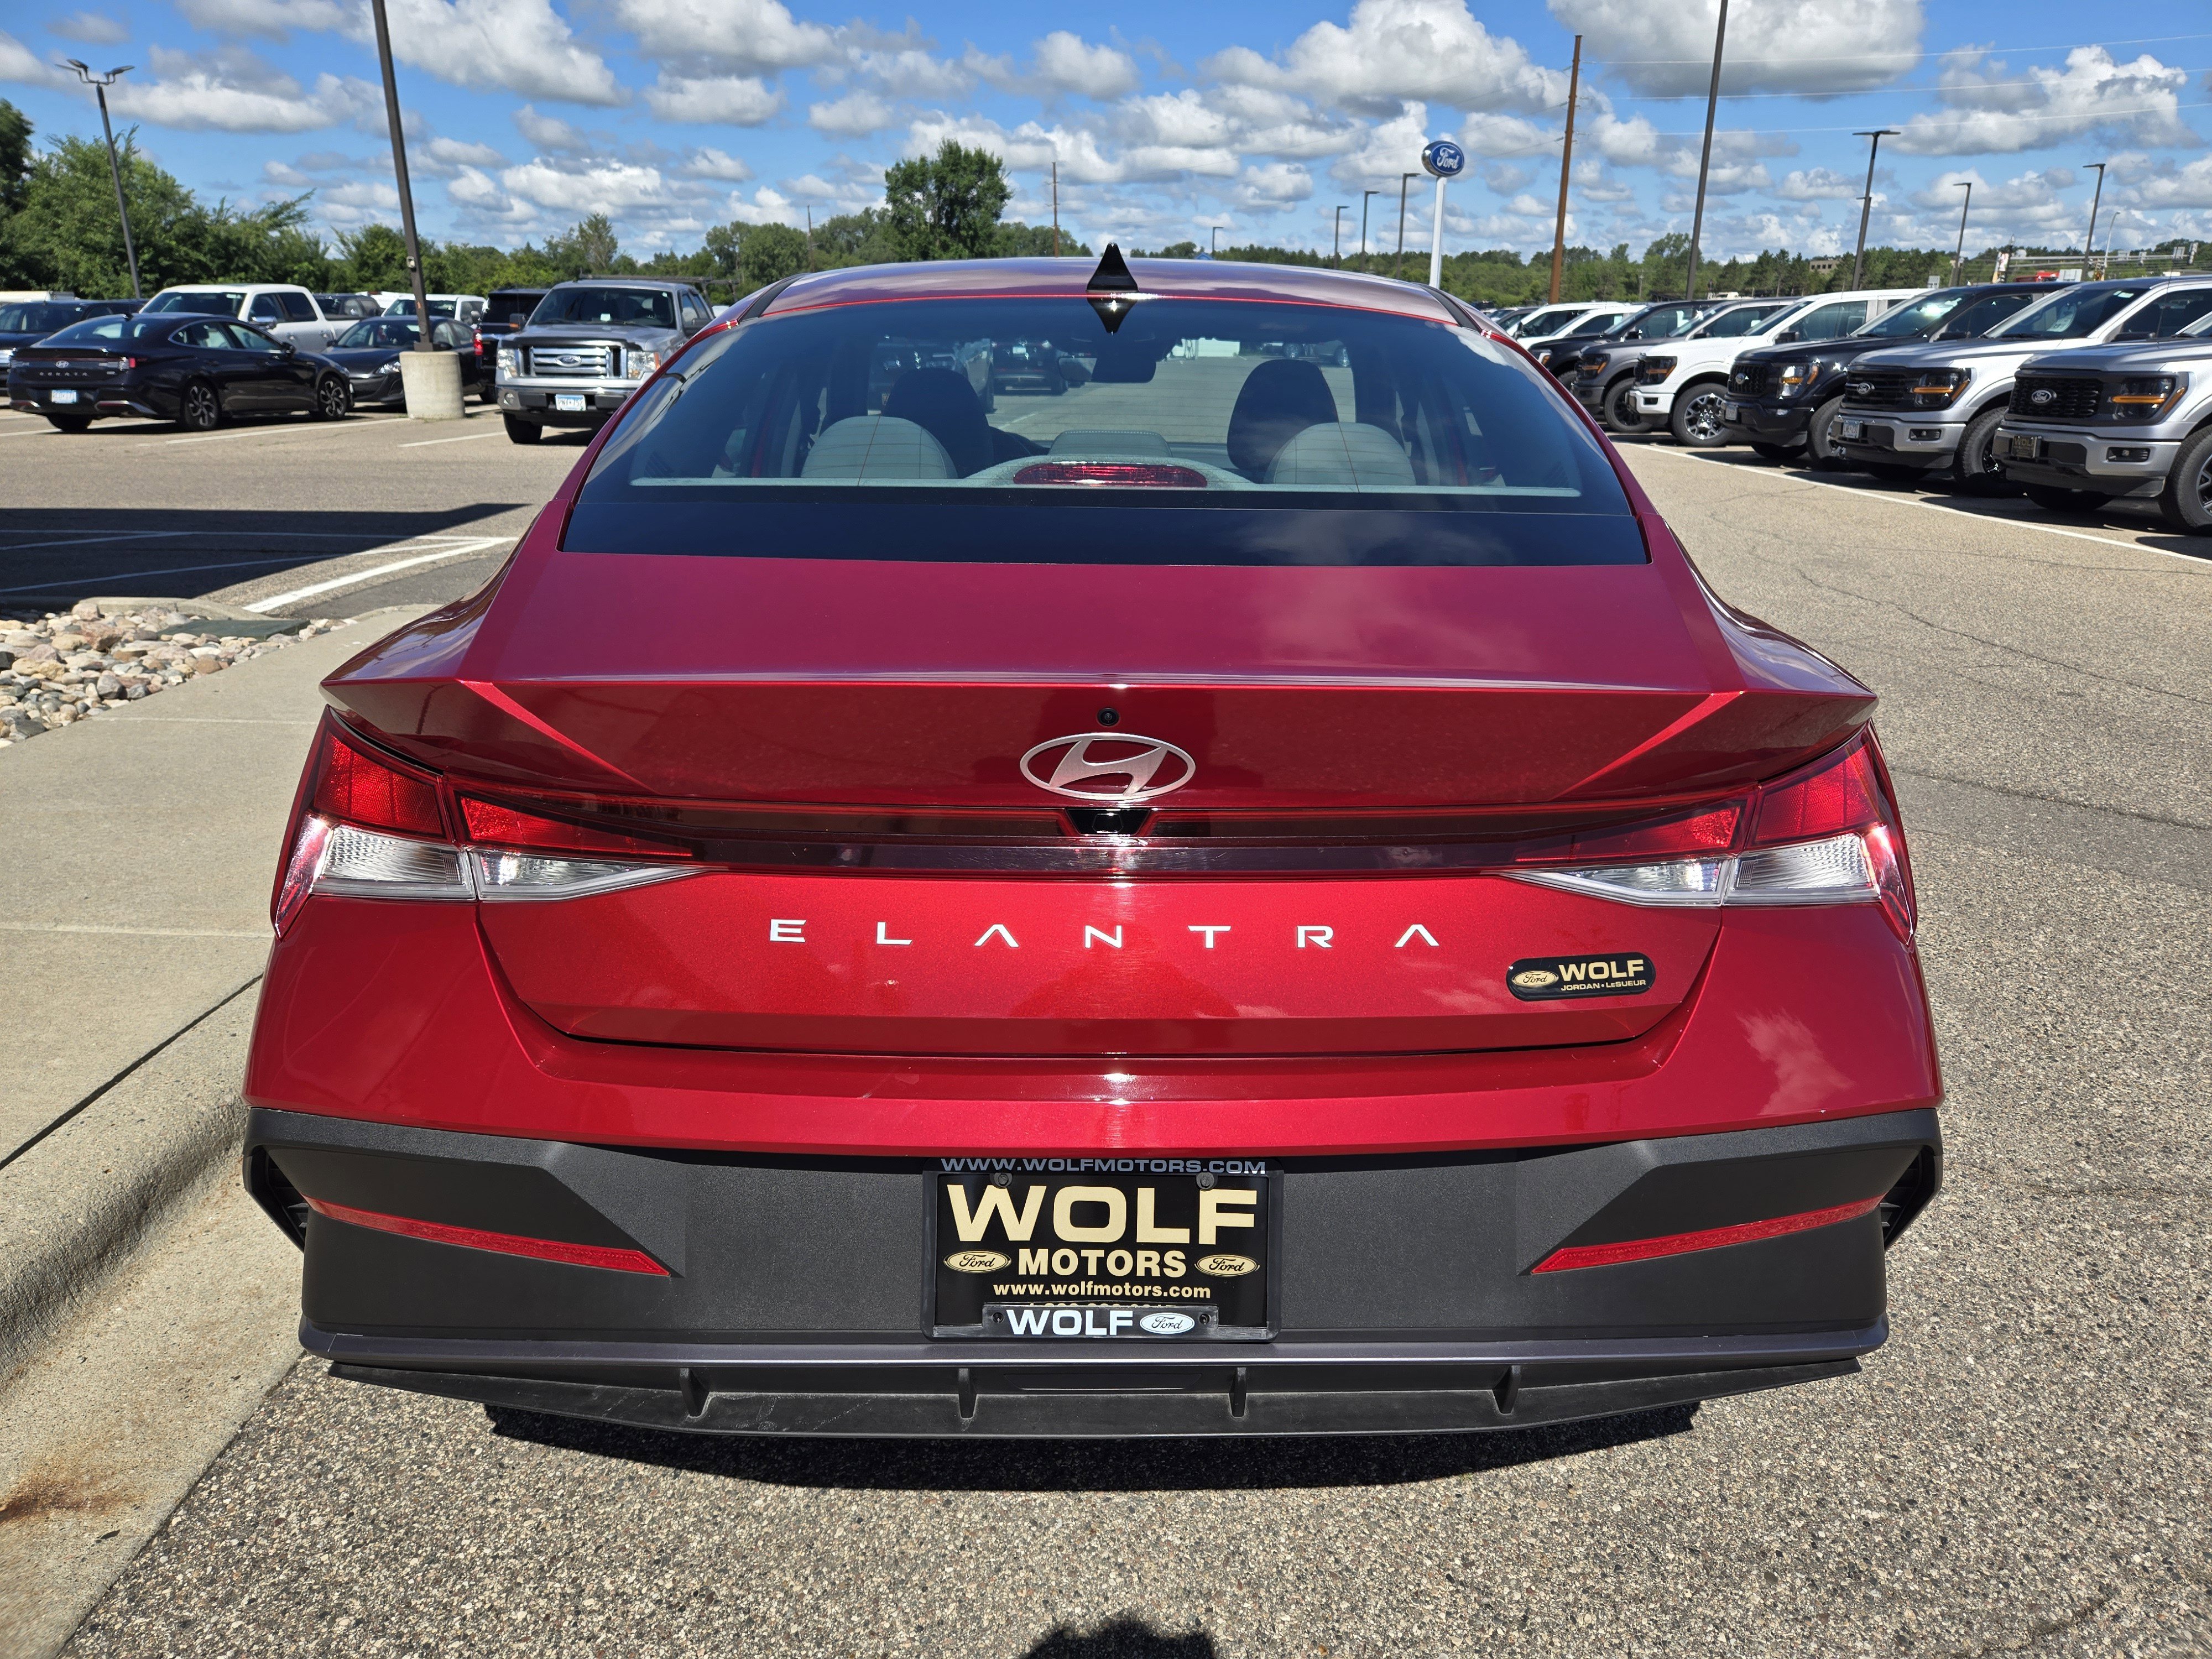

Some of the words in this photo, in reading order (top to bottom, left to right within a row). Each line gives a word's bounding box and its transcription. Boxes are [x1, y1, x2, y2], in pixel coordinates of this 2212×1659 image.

[1437, 147, 1460, 169] Ford
[769, 919, 1439, 948] ELANTRA
[1523, 974, 1547, 983] Ford
[1559, 959, 1644, 982] WOLF
[1561, 983, 1600, 991] JORDAN
[941, 1158, 1265, 1175] WWW.WOLFMOTORS.COM
[947, 1184, 1258, 1245] WOLF
[959, 1254, 995, 1267] Ford
[1018, 1249, 1186, 1277] MOTORS
[1209, 1258, 1244, 1272] Ford
[993, 1281, 1211, 1298] www.wolfmotors.com
[1005, 1310, 1133, 1335] WOLF
[1151, 1316, 1183, 1329] Ford
